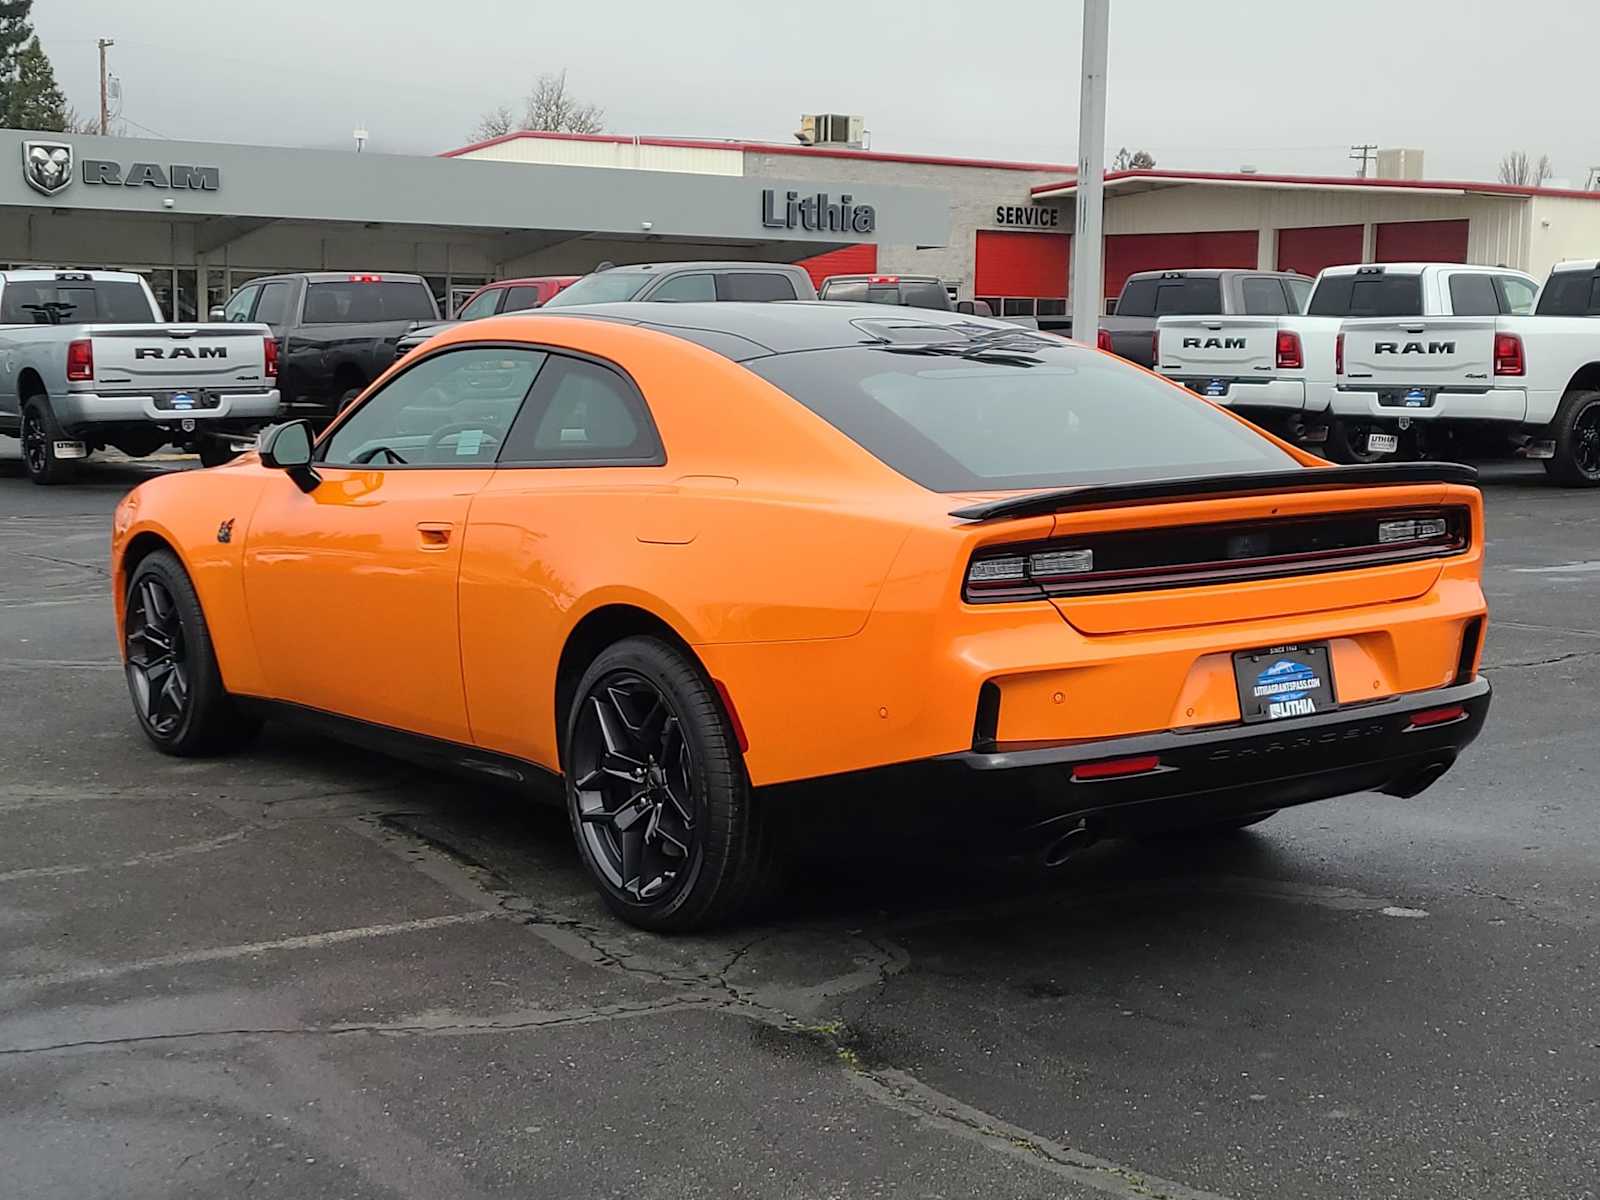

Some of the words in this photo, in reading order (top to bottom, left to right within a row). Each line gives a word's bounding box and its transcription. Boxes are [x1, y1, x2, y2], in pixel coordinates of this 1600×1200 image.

[82, 159, 219, 191] RAM
[762, 189, 876, 233] Lithia
[995, 205, 1059, 228] SERVICE
[134, 346, 228, 360] RAM
[1183, 337, 1247, 349] RAM
[1374, 341, 1456, 354] RAM
[1279, 697, 1317, 718] LITHIA
